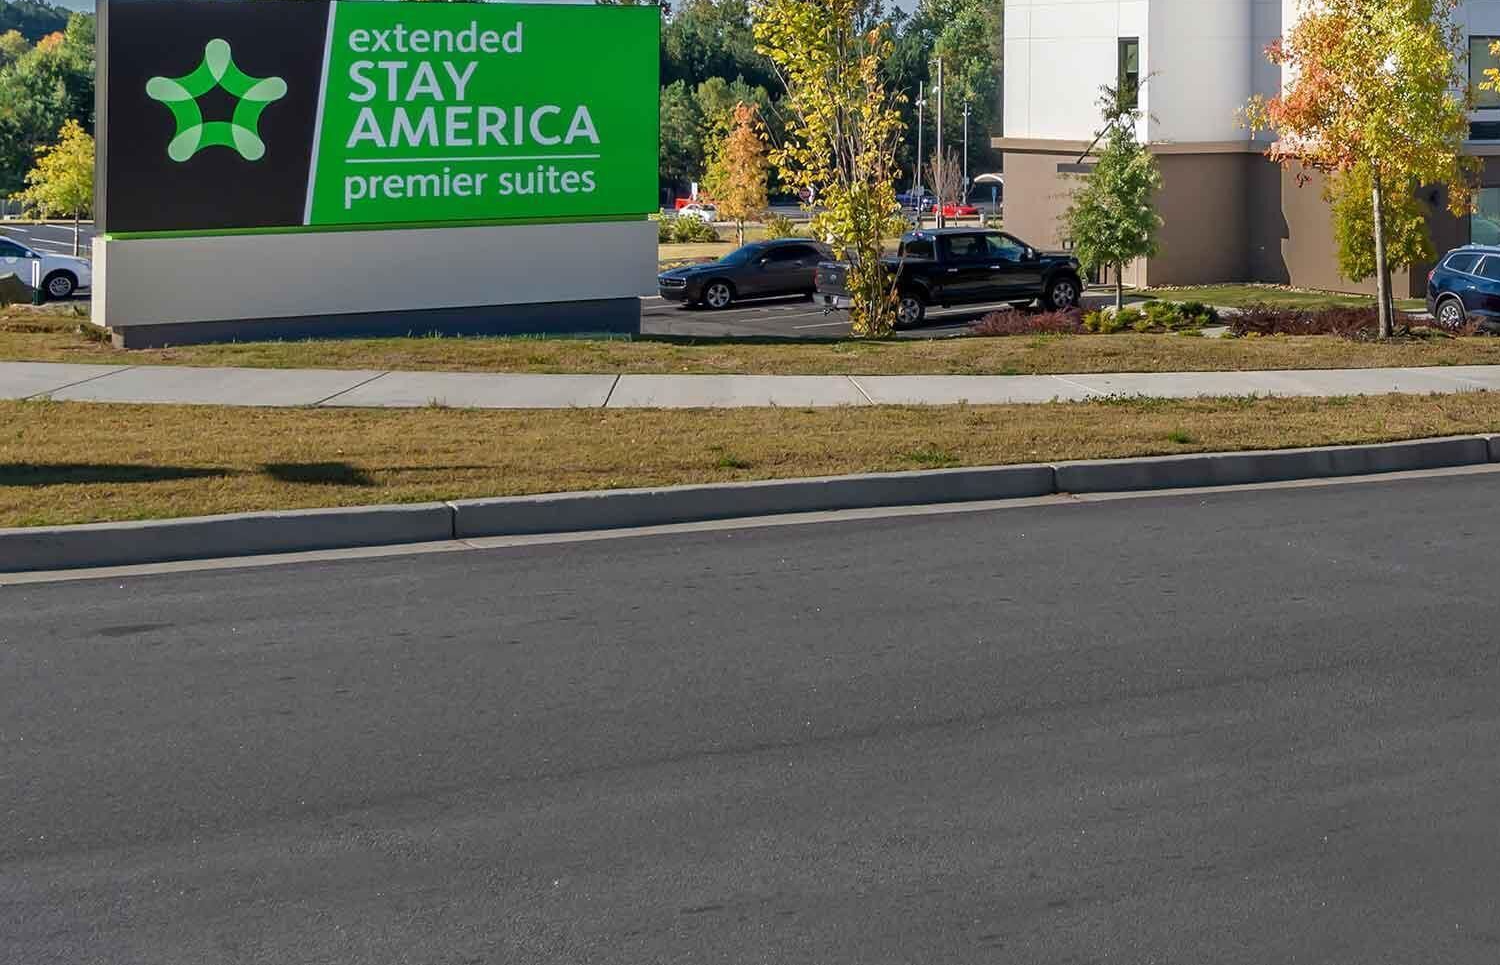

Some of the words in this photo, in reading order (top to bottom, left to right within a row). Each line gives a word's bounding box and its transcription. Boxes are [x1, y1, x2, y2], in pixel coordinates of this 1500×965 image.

[348, 20, 523, 54] extended
[348, 60, 479, 103] STAY
[345, 104, 601, 148] AMERICA
[344, 167, 488, 210] premier
[498, 164, 597, 196] suites
